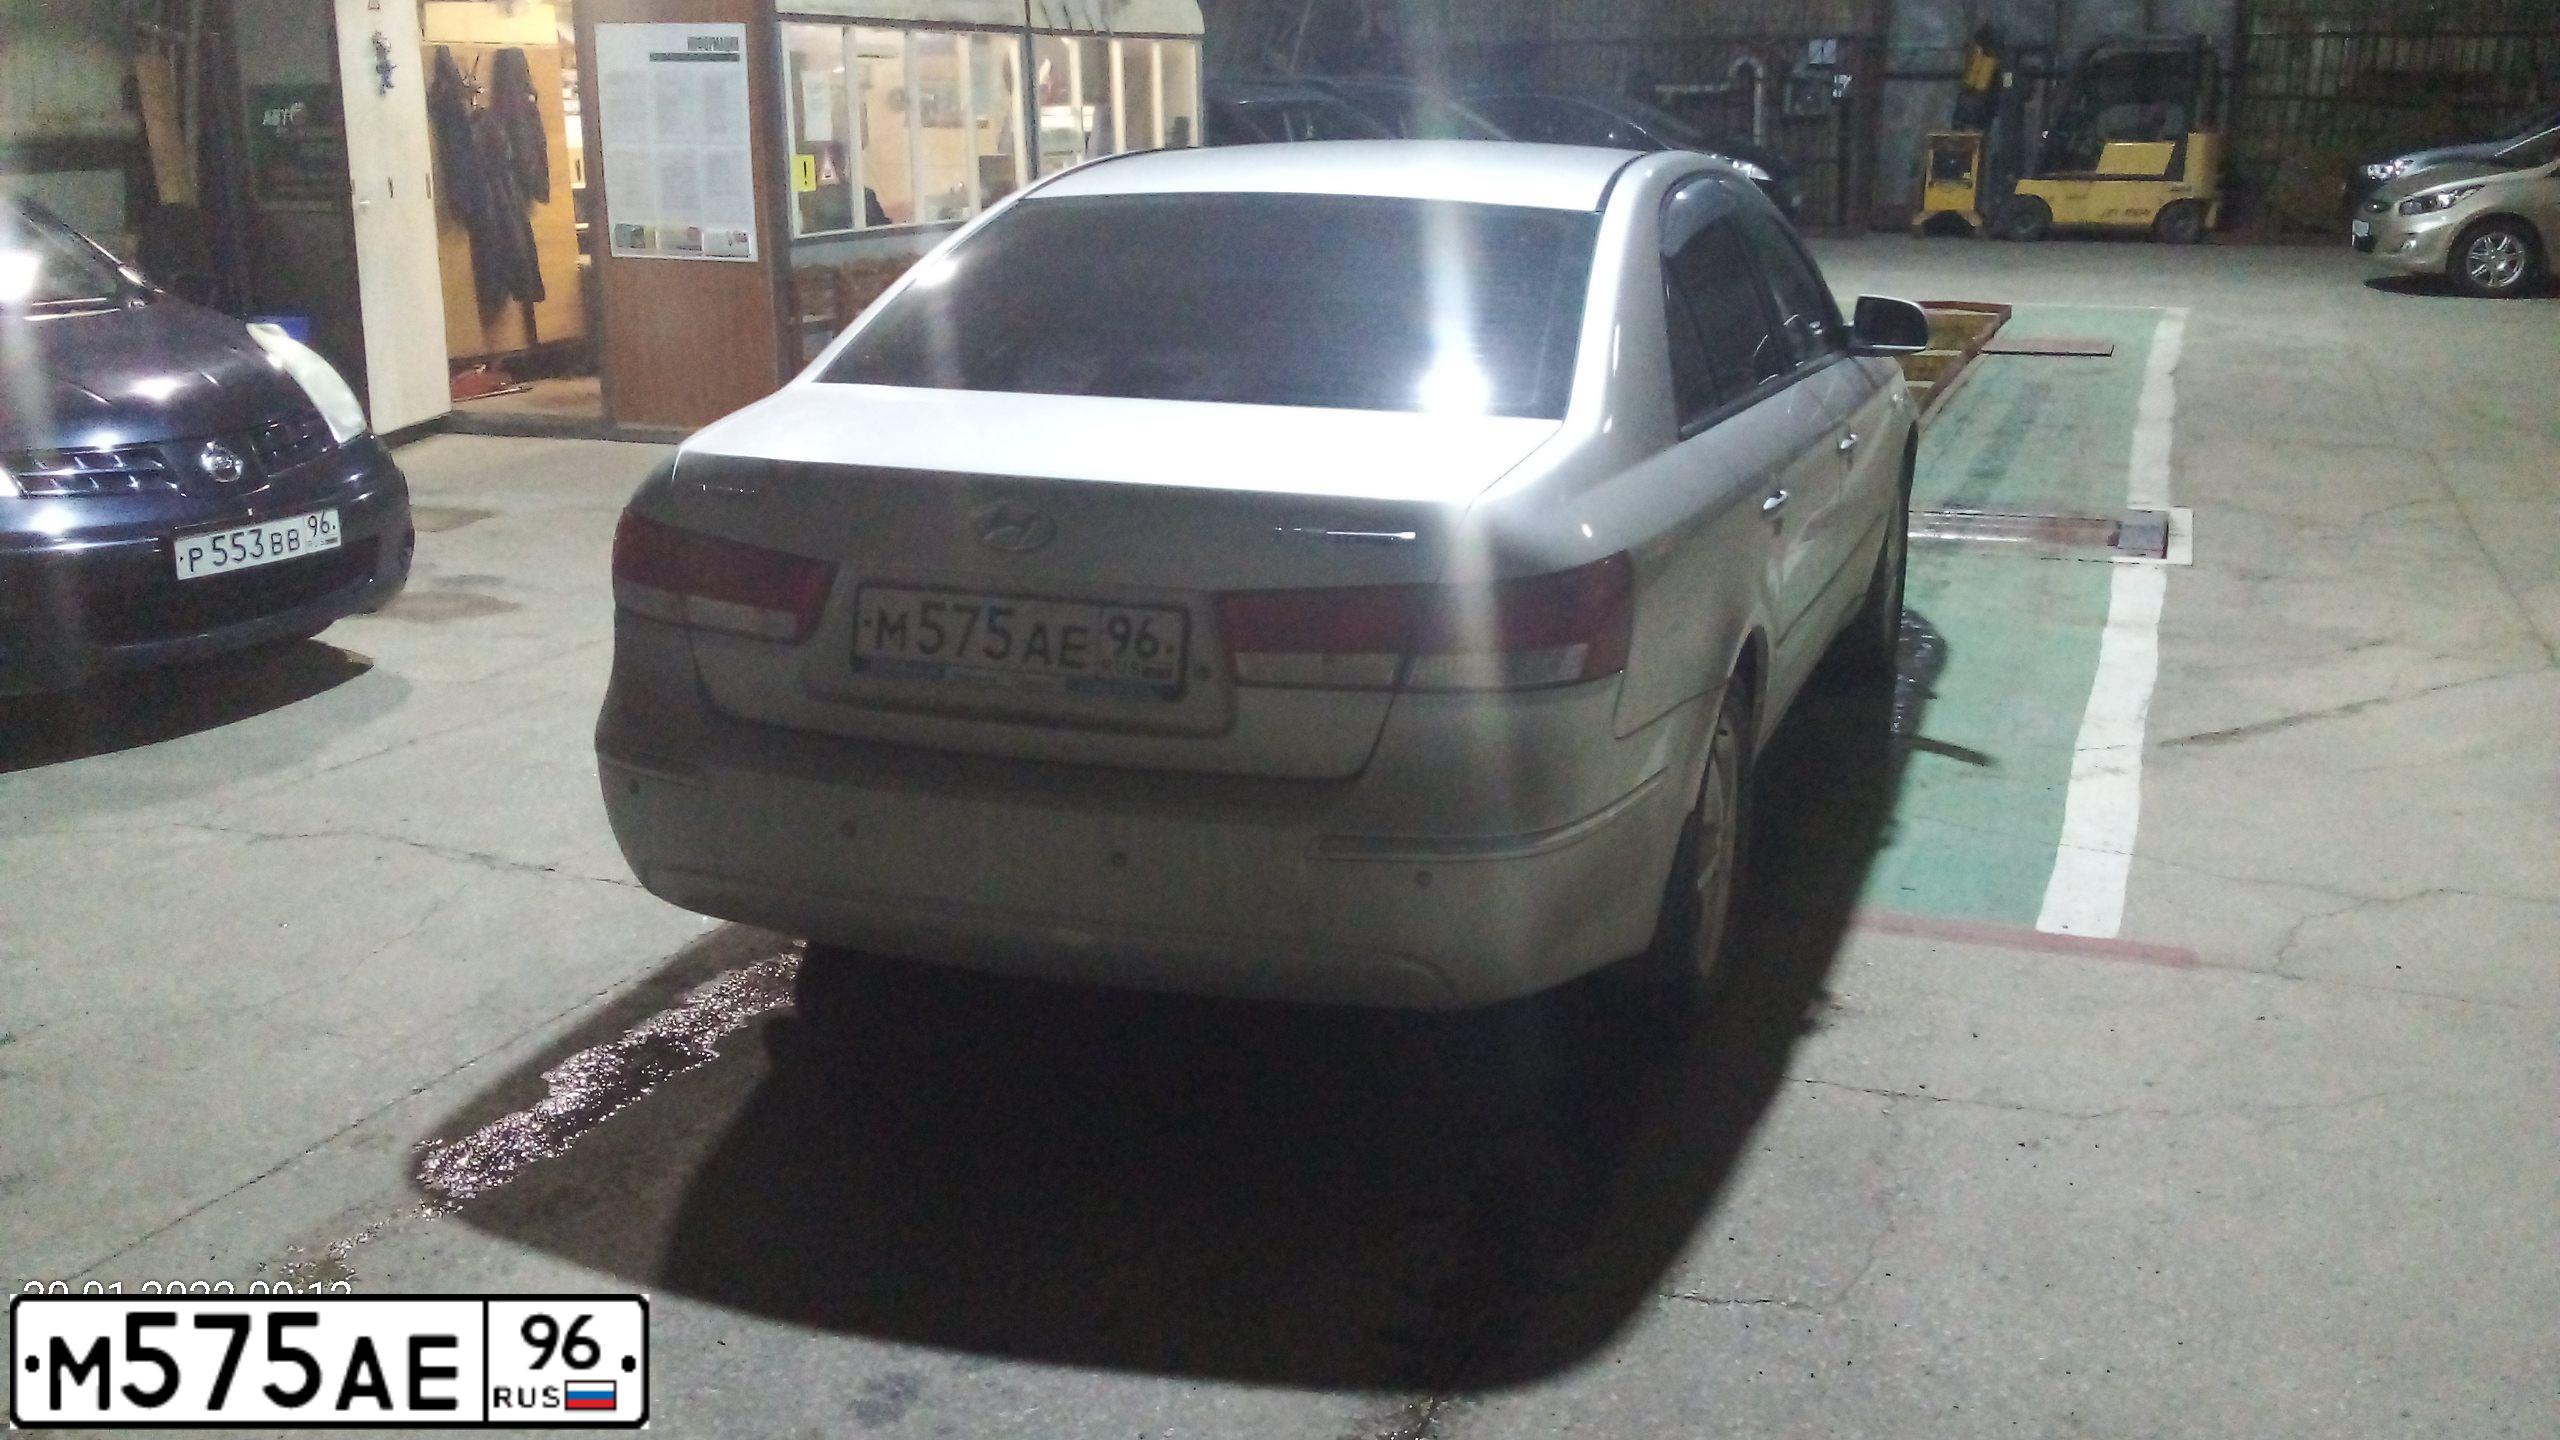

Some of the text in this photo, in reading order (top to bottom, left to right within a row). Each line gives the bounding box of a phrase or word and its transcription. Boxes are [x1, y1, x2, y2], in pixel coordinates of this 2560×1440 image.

[307, 511, 330, 537] 96
[876, 601, 1160, 669] М575АЕ 96
